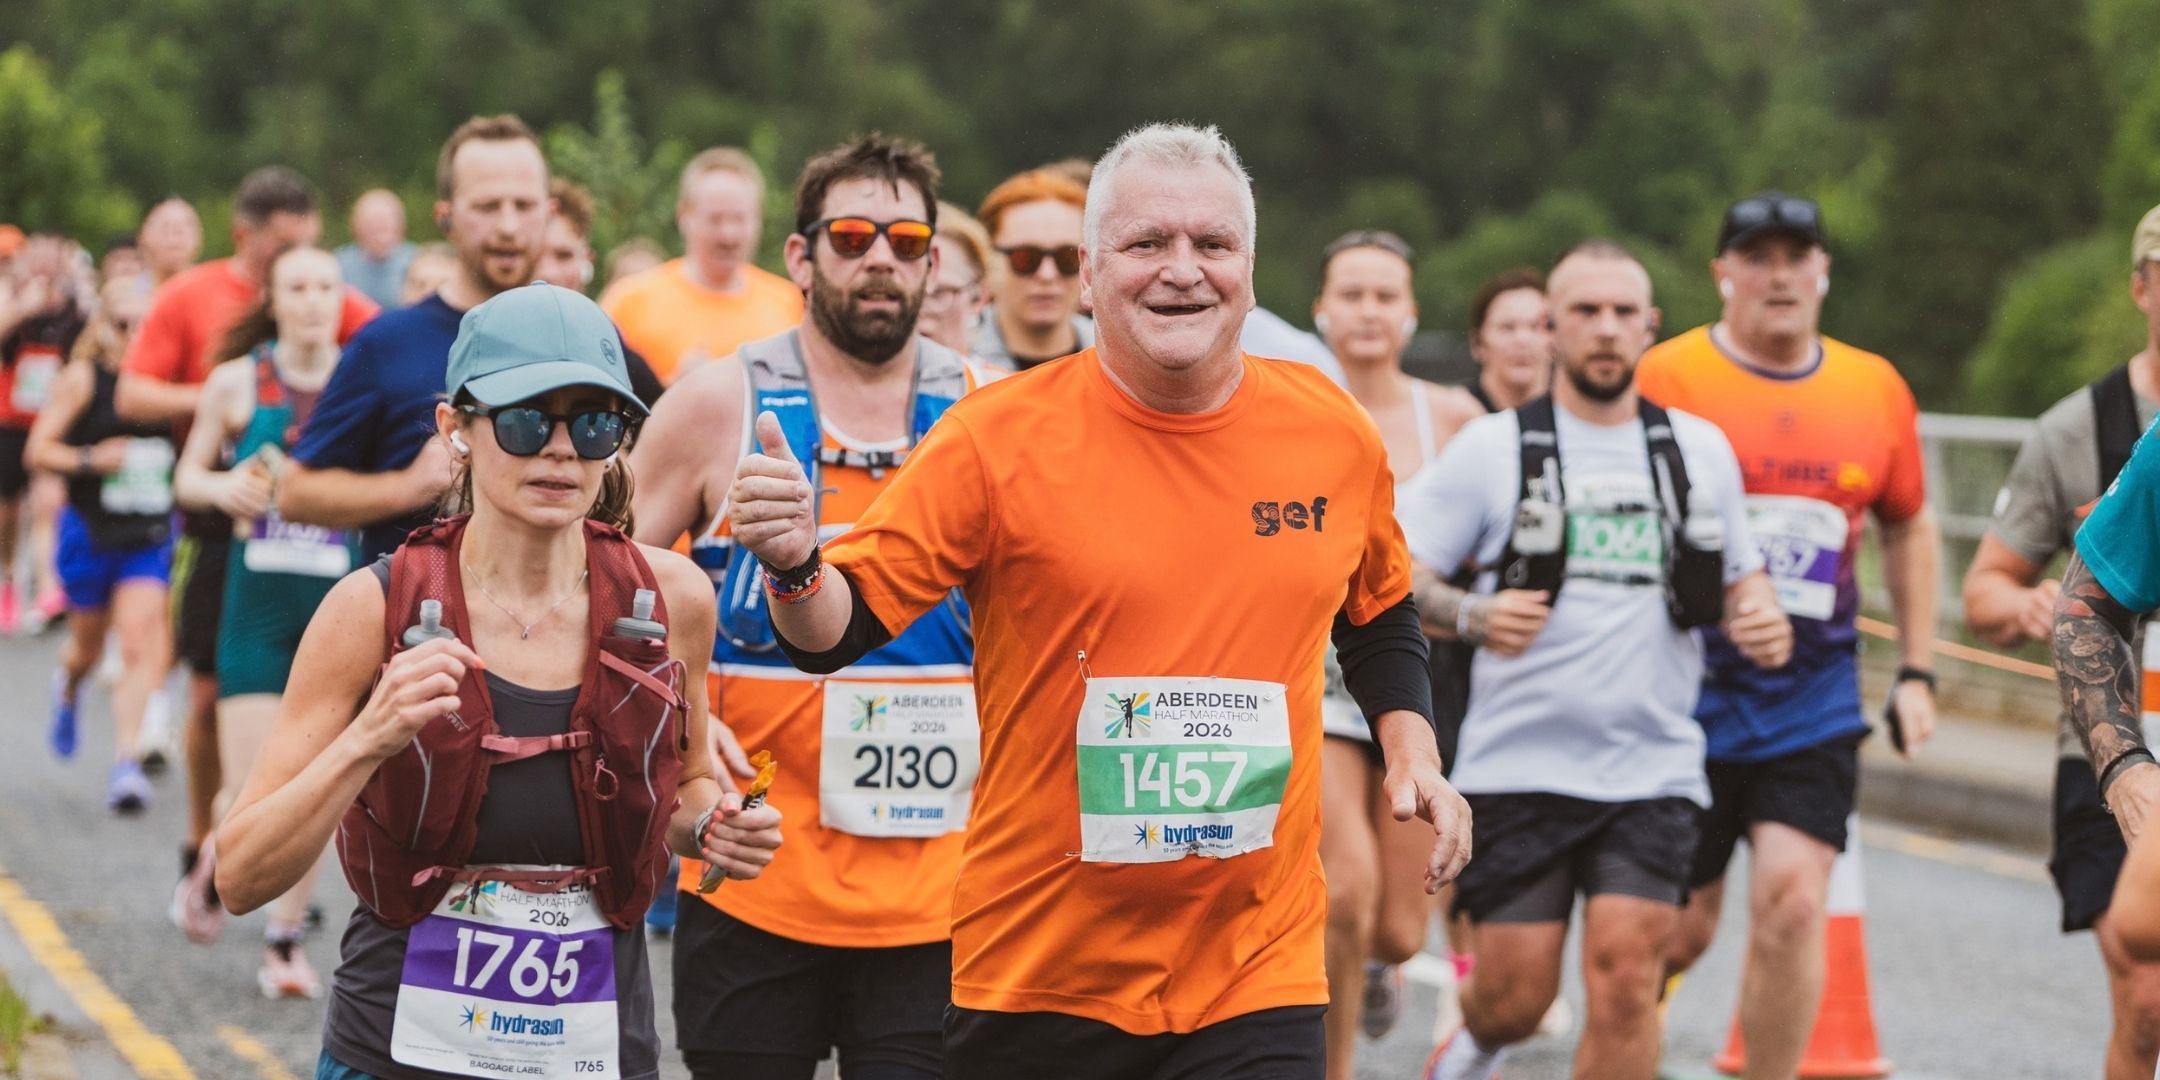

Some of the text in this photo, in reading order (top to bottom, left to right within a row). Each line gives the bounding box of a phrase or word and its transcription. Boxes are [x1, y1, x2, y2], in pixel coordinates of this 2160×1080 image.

[1252, 496, 1328, 537] gef
[891, 694, 963, 709] ABERDEEN
[1155, 692, 1258, 710] ABERDEEN
[443, 711, 465, 731] SPREY
[1154, 710, 1258, 722] HALF MARATHON
[911, 721, 946, 734] 2026
[1183, 723, 1232, 738] 2026
[853, 744, 957, 789] 2130
[1120, 751, 1248, 808] 1457
[1164, 824, 1233, 845] hydrasun
[500, 892, 534, 906] HALF
[453, 927, 584, 998] 1765
[470, 1060, 545, 1075] BAGGAGE LABEL
[575, 1061, 604, 1073] 1765
